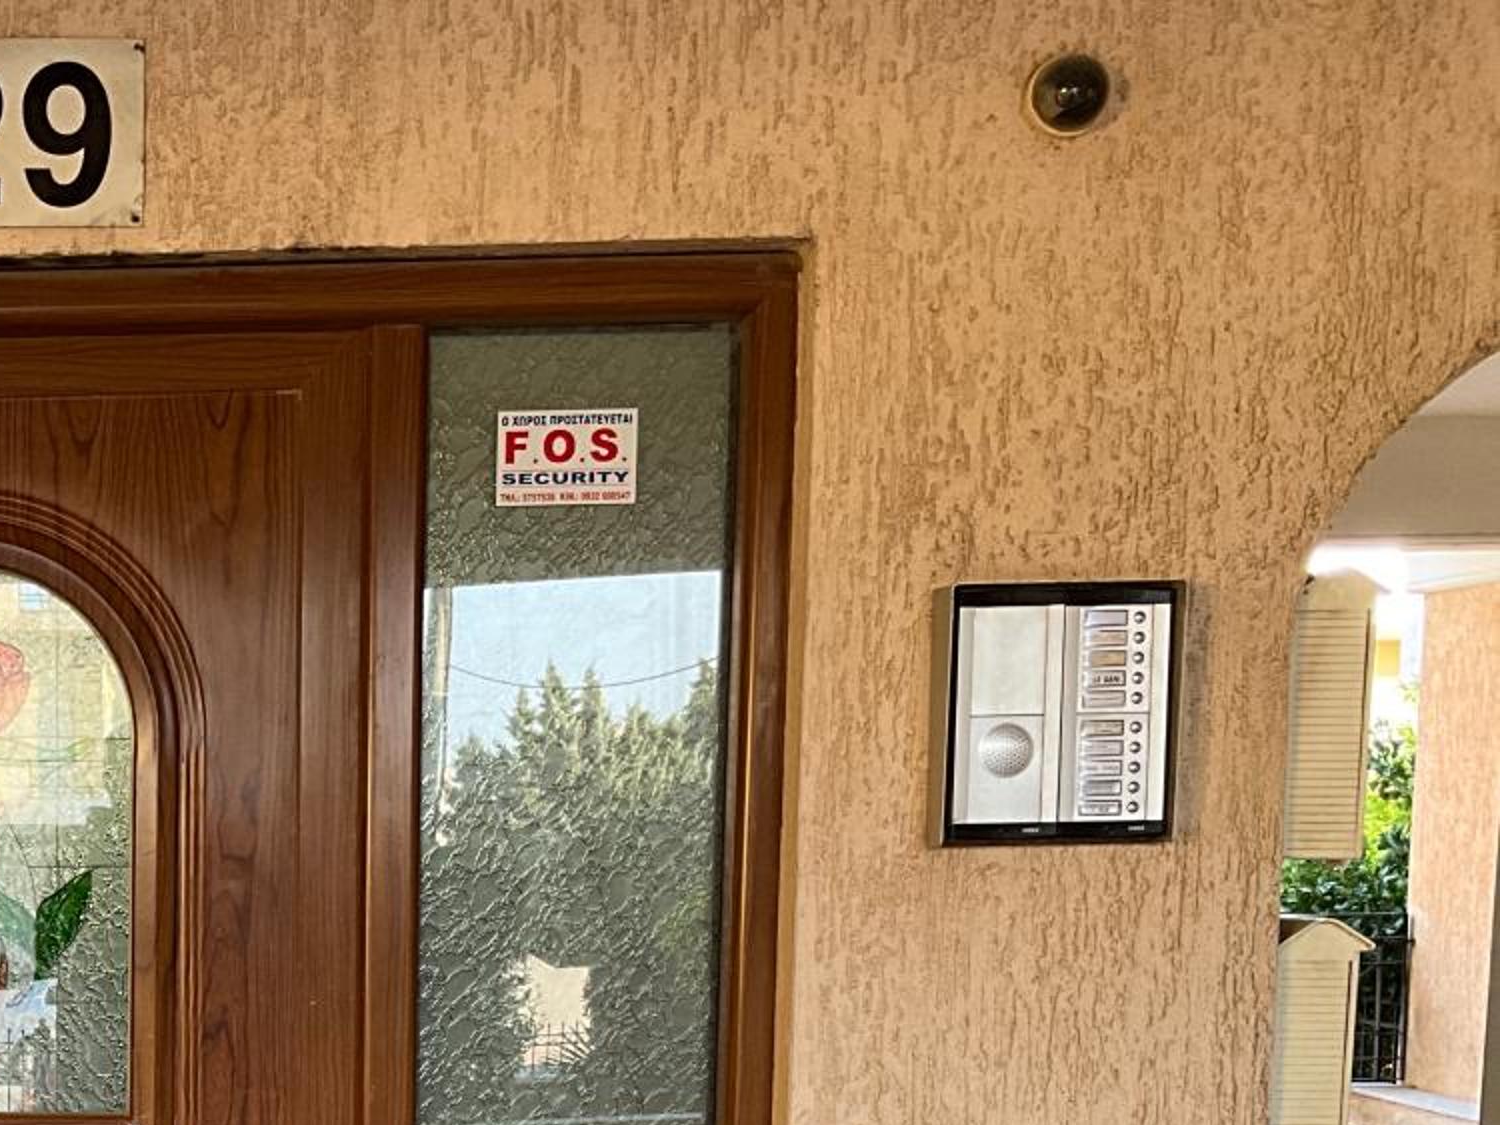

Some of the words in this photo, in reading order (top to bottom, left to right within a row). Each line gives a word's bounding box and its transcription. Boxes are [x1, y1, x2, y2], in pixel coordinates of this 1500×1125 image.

[512, 416, 546, 426] ΧΩΡΟΣ
[550, 414, 632, 425] ΠΡΟΣΤΑΤΕΥΕΤΑΙ
[505, 428, 627, 464] F.O.S.
[502, 471, 628, 485] SECURITY
